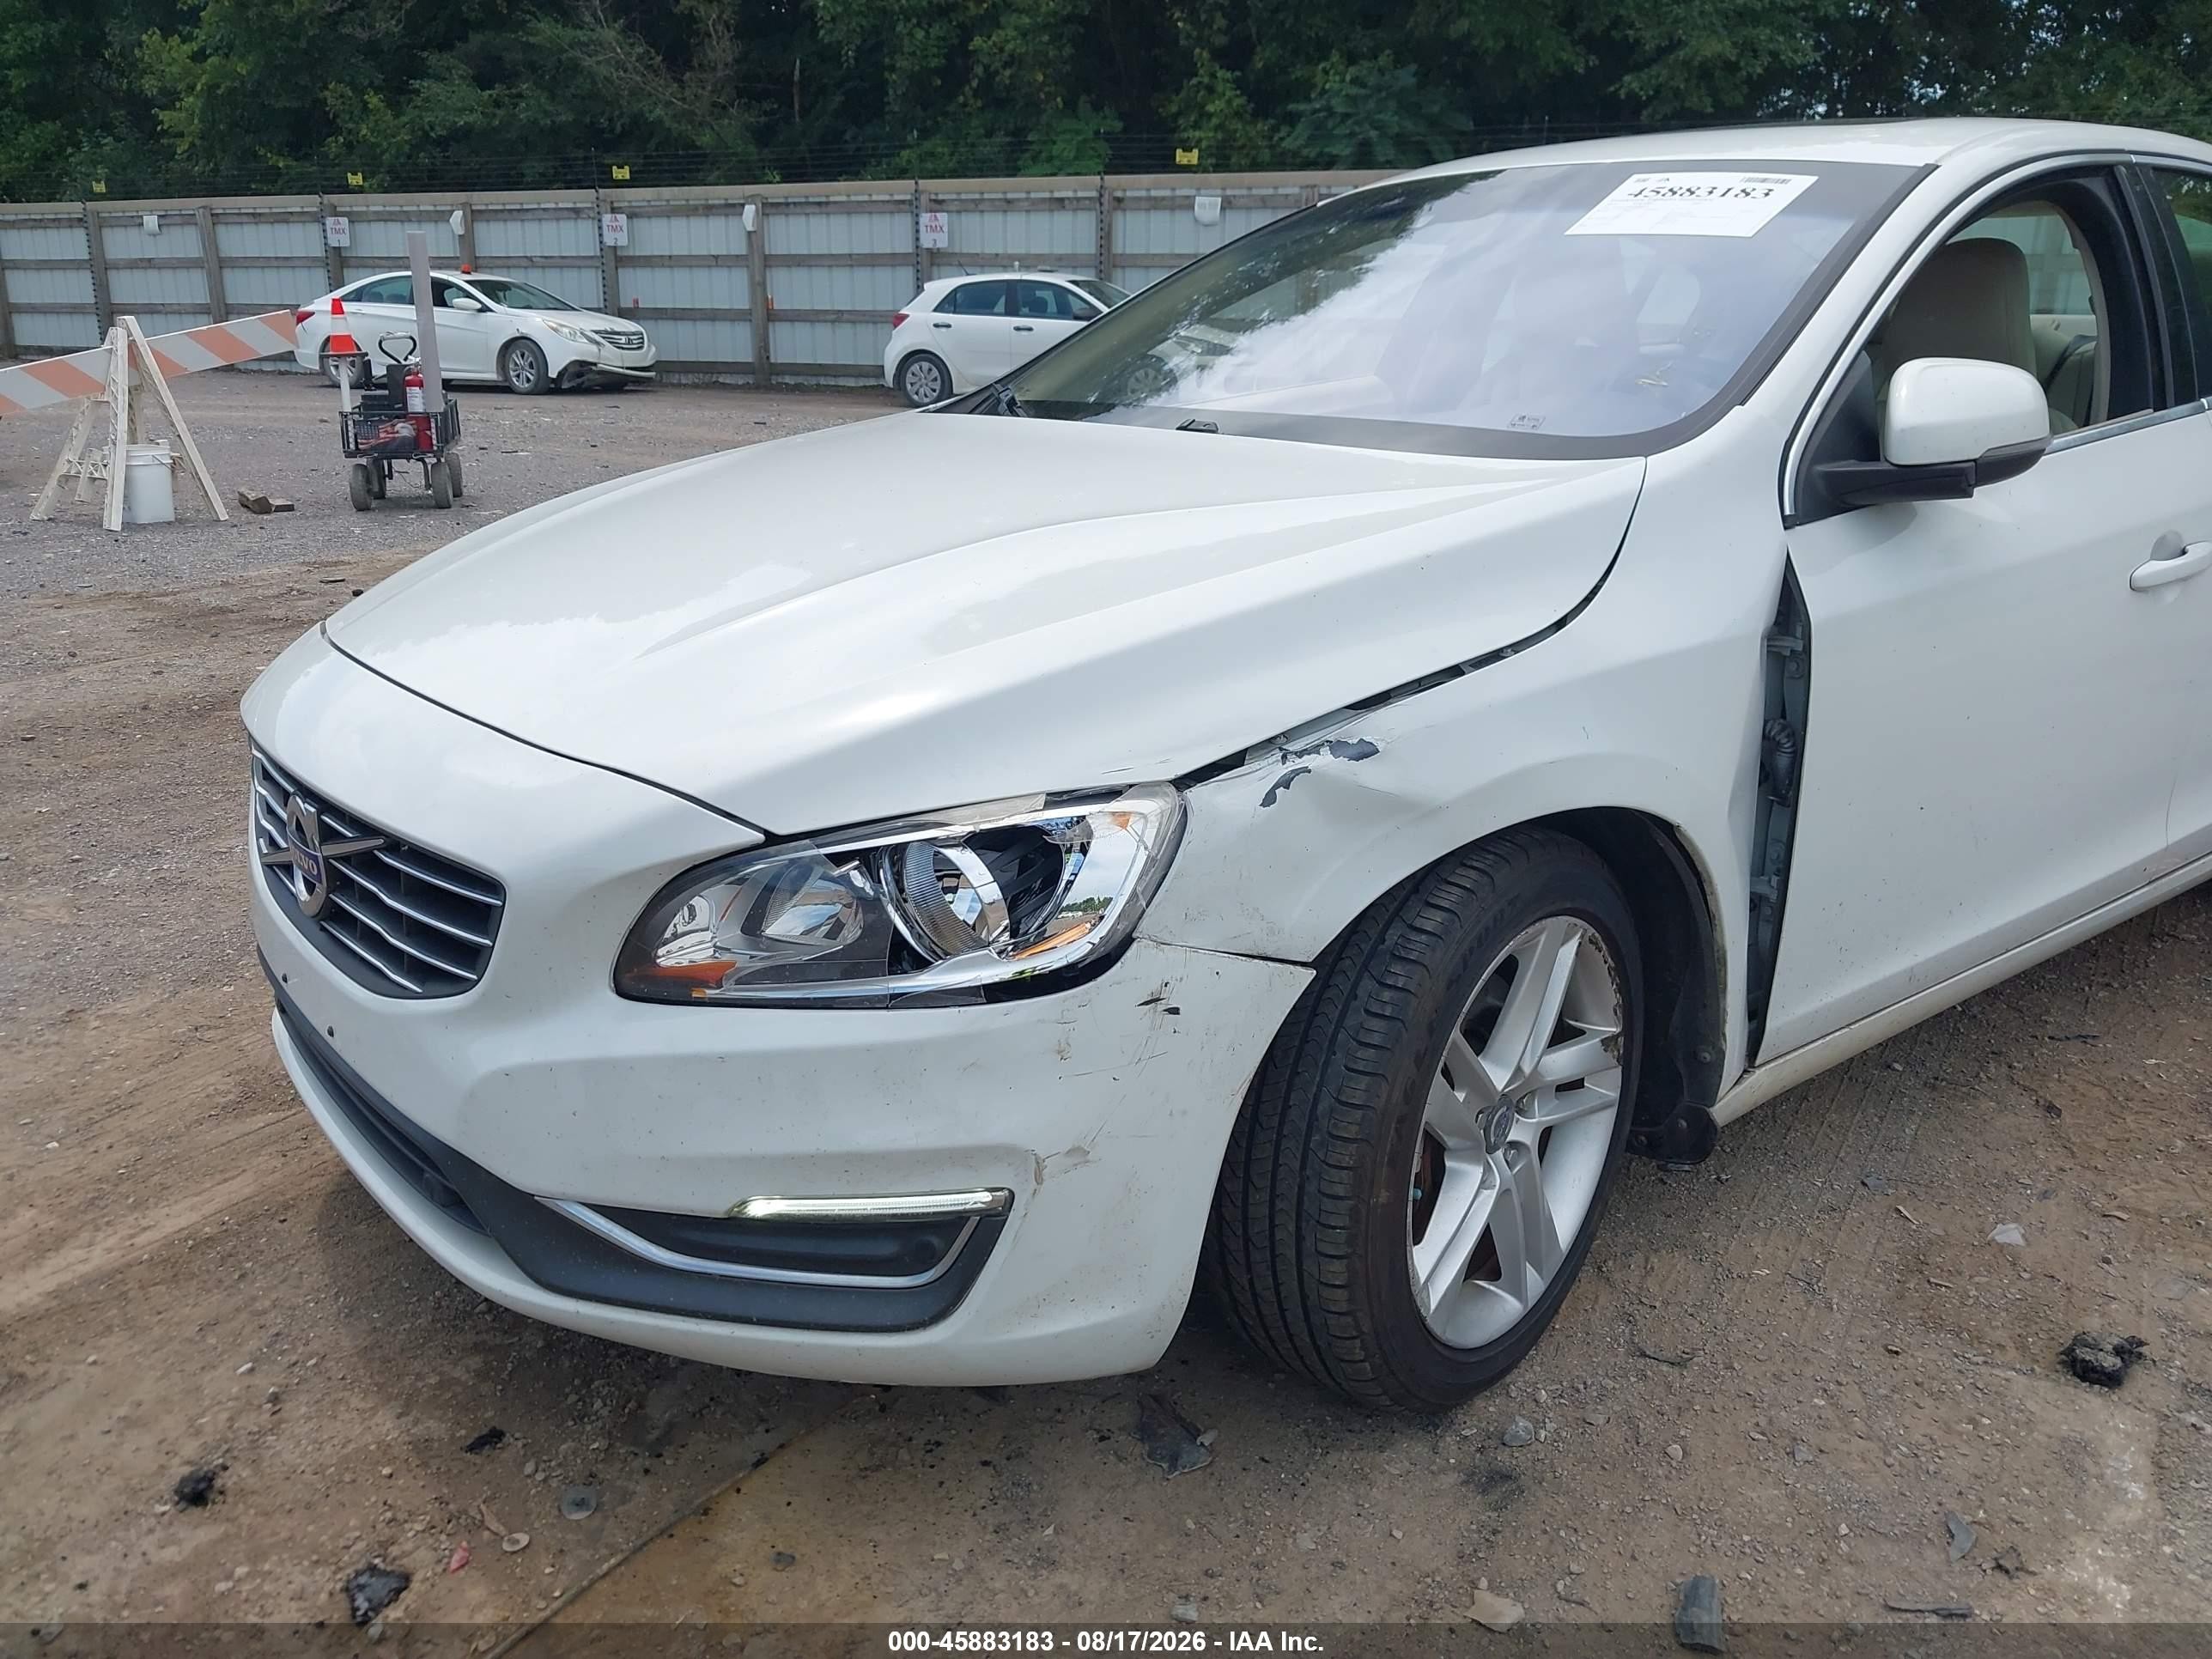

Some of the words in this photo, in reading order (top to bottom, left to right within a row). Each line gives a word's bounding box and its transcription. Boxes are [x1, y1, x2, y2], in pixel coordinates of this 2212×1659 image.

[1627, 185, 1774, 199] 45883183
[330, 227, 346, 235] TMX
[606, 224, 623, 234] TMX
[924, 224, 945, 234] TMX
[290, 845, 318, 876] LVO
